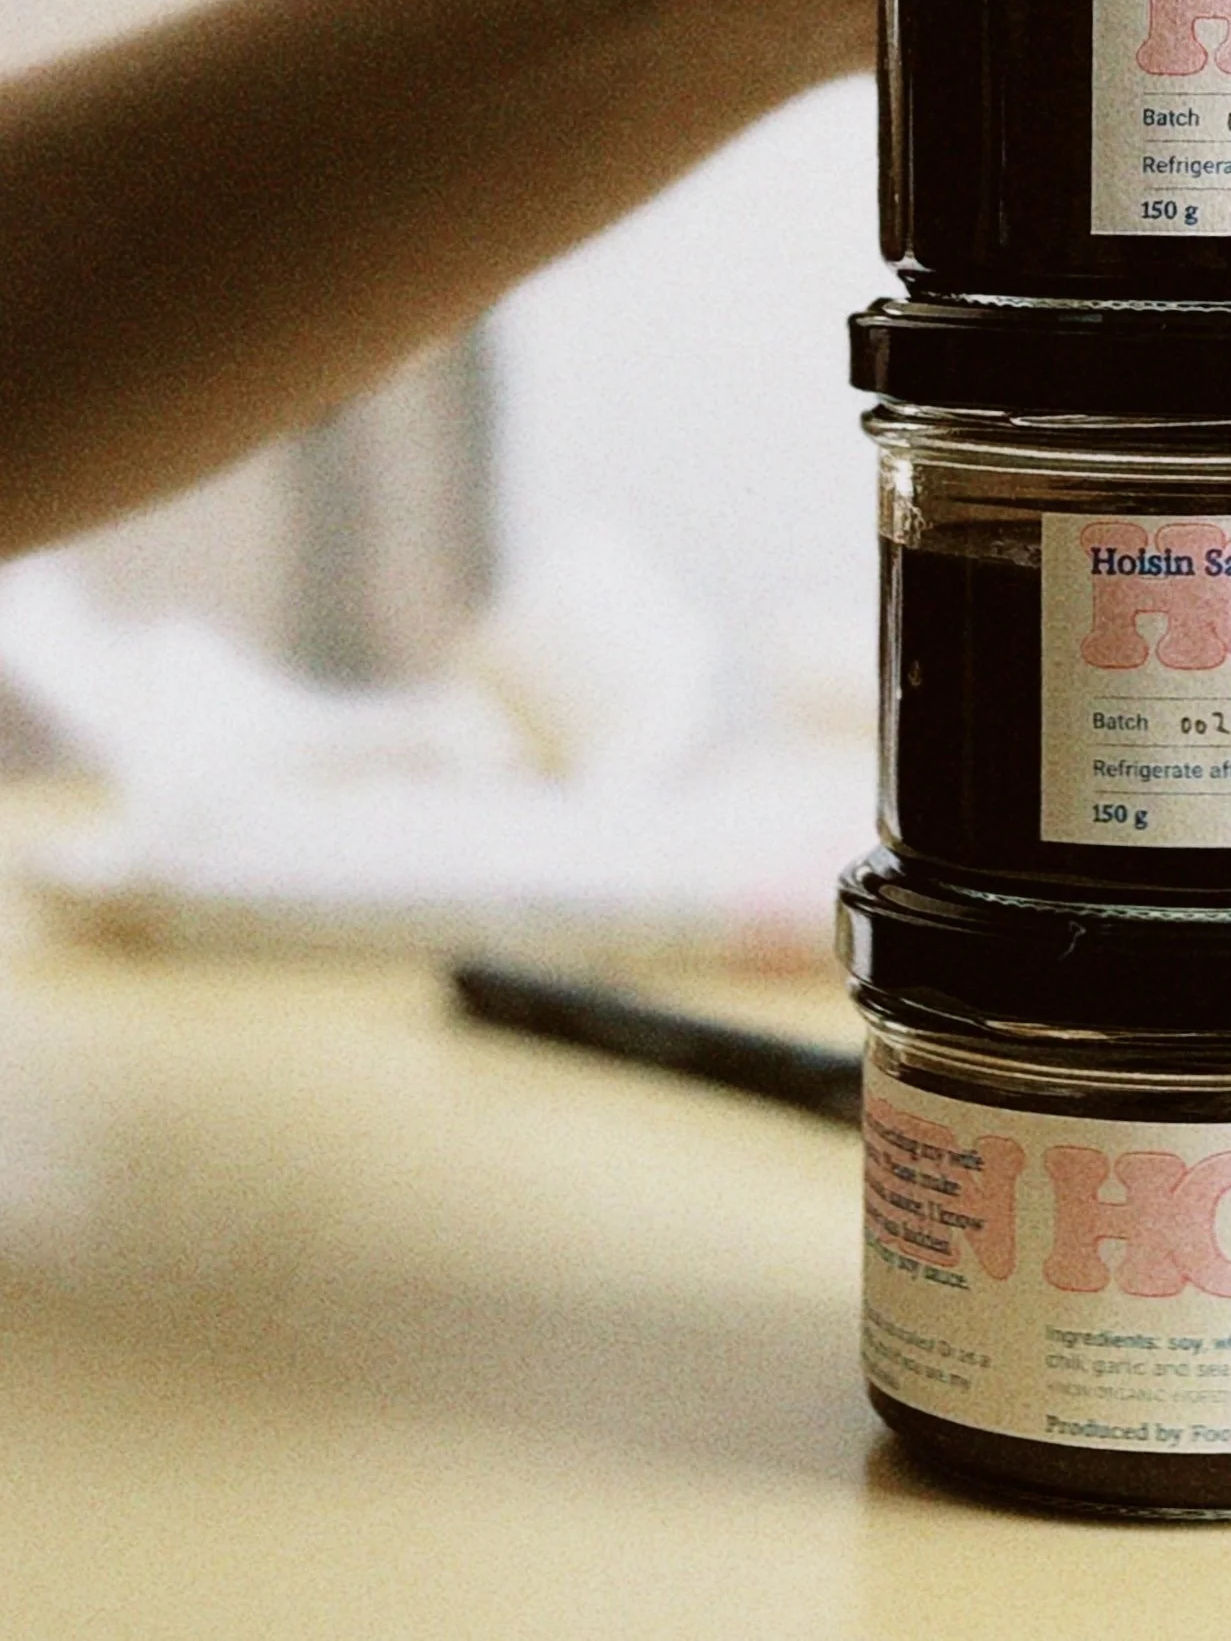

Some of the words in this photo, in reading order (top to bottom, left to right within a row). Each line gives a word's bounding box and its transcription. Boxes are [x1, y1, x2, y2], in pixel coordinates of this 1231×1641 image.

[1142, 109, 1200, 128] Batch
[1140, 201, 1178, 221] 150
[1184, 205, 1199, 225] g
[1090, 547, 1195, 576] Hoisin
[1092, 712, 1148, 731] Batch
[1180, 712, 1230, 735] 002
[1092, 760, 1203, 781] Refrigerate
[1092, 804, 1127, 823] 150
[1134, 809, 1148, 829] g
[1044, 1414, 1149, 1442] Produced
[1153, 1422, 1184, 1448] by
